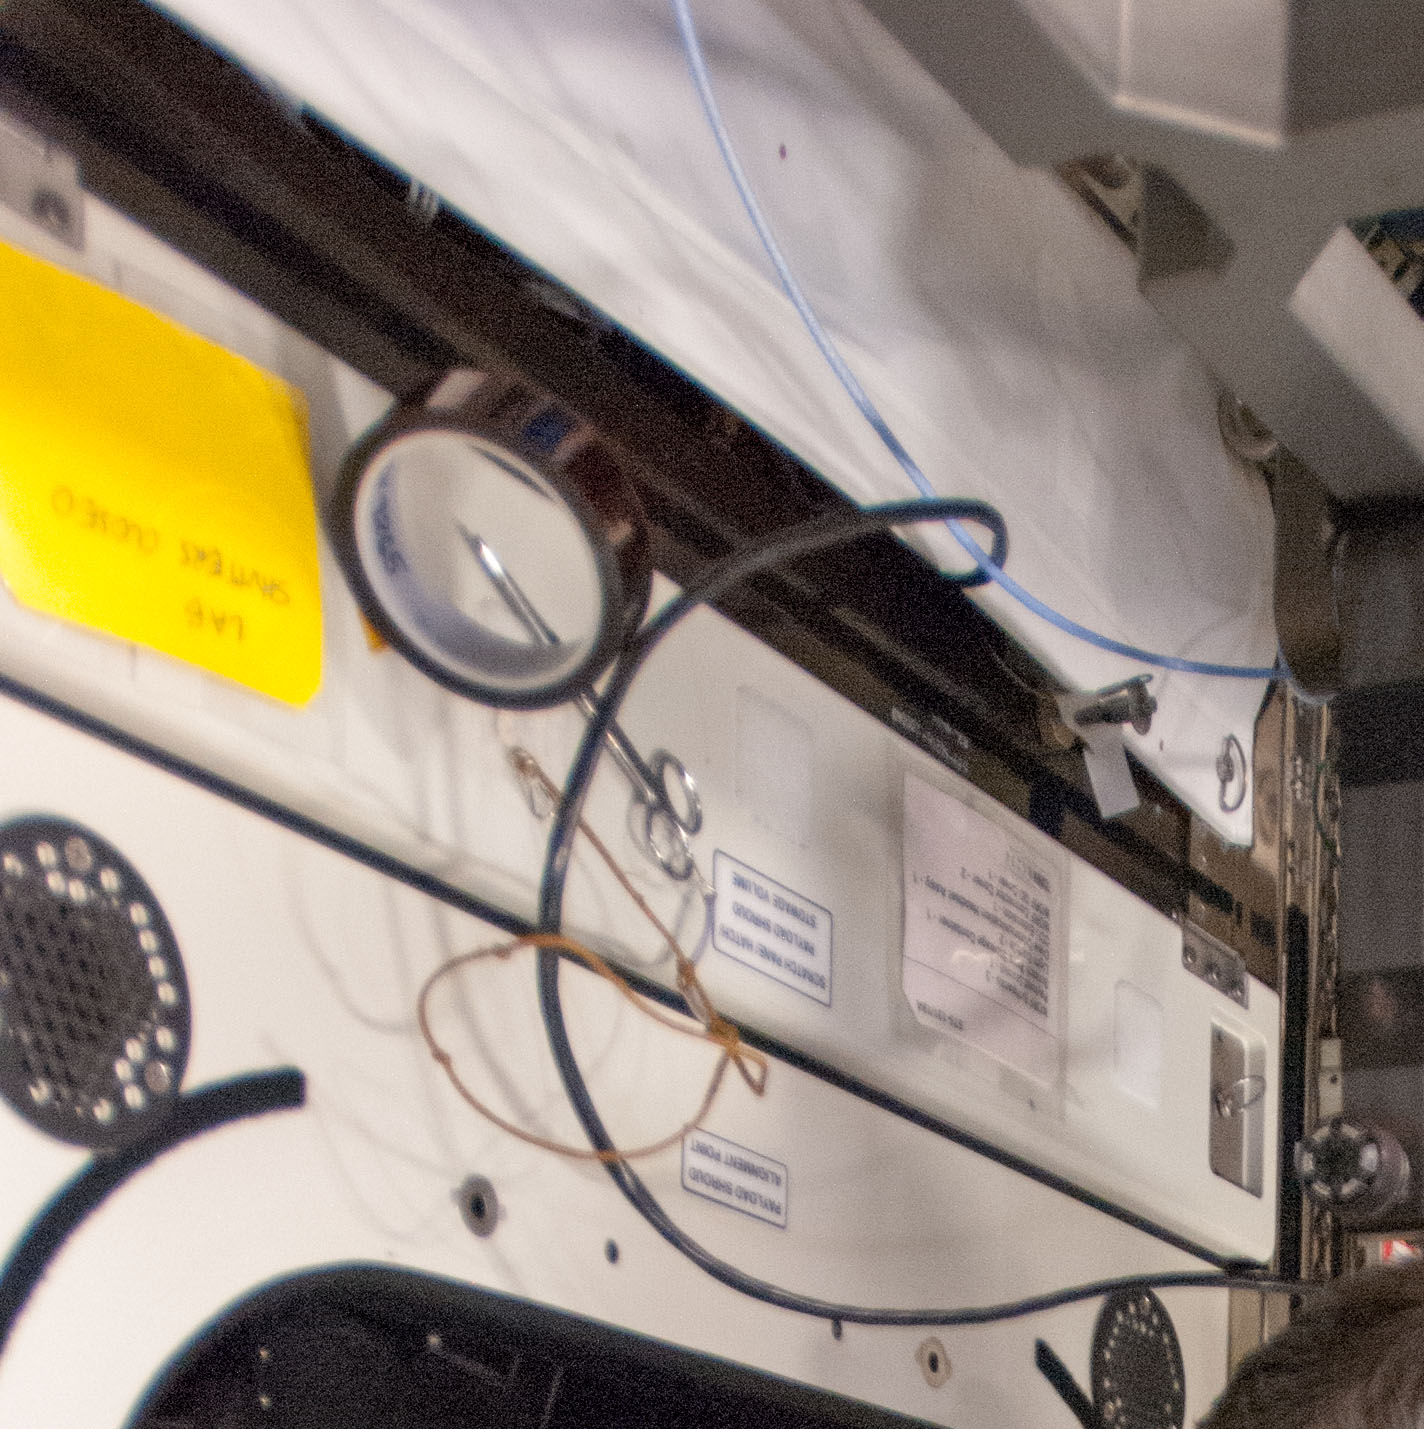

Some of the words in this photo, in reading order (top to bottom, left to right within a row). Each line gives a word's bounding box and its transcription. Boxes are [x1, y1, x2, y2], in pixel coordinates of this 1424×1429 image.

[732, 871, 769, 903] VOLUME
[723, 1151, 781, 1187] ALIGNMENT
[734, 1183, 781, 1216] PAYLOAD
